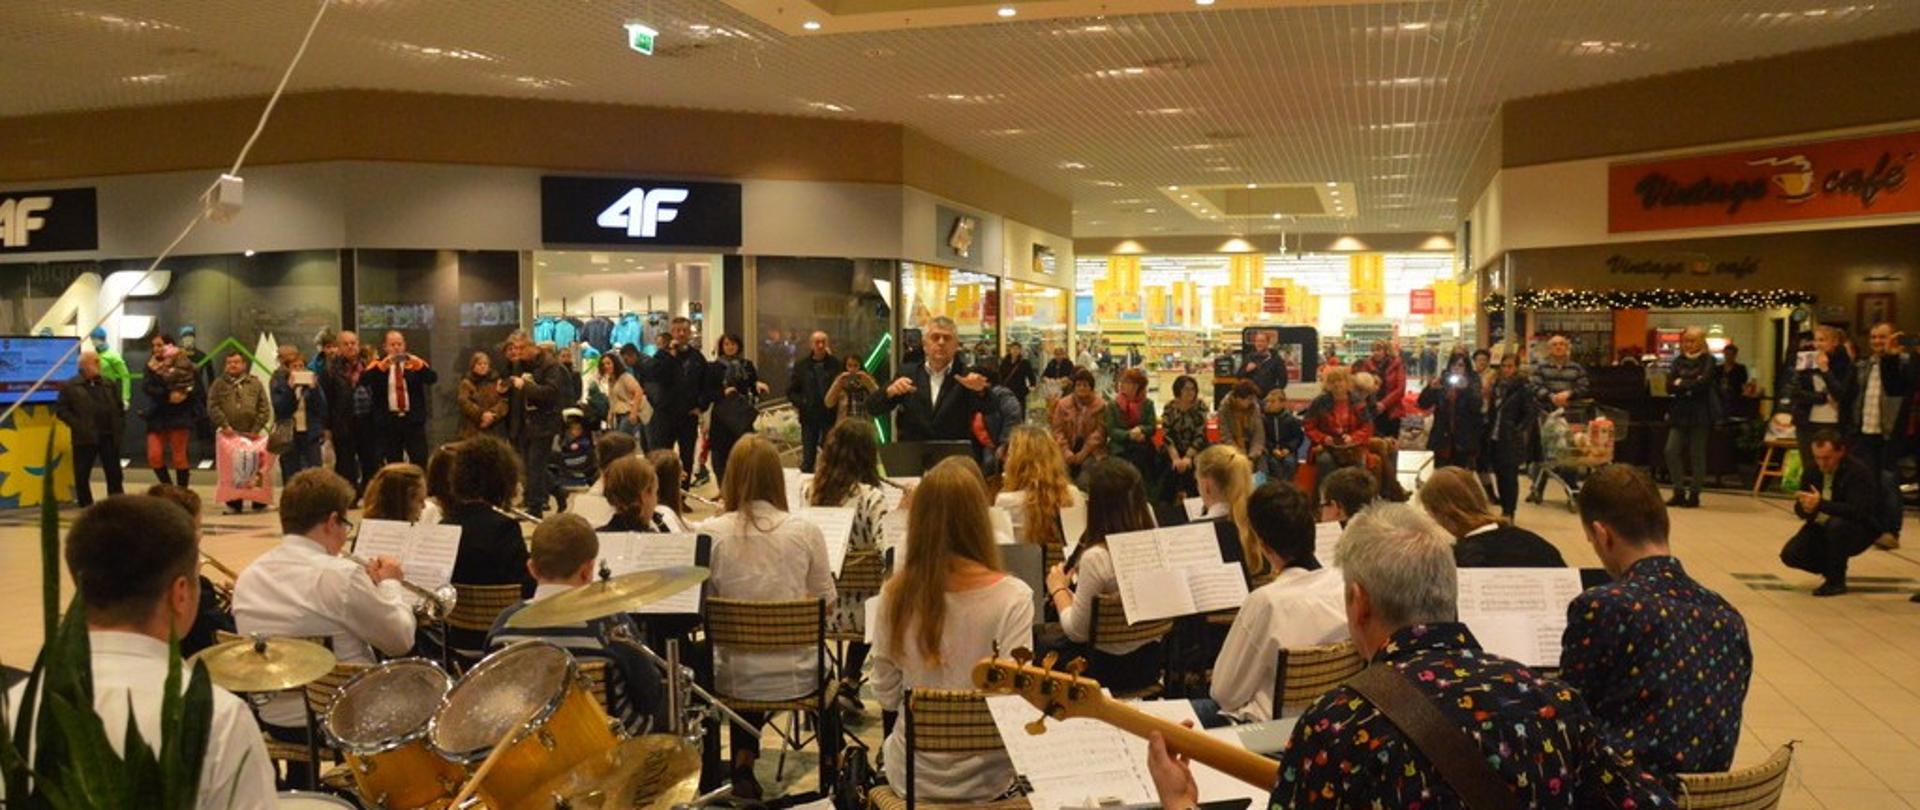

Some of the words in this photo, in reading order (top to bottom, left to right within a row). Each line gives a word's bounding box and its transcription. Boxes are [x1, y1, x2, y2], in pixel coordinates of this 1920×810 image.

[1634, 171, 1768, 215] Vintage
[1823, 151, 1913, 208] café
[596, 187, 689, 237] 4F
[1606, 254, 1684, 280] Vintage
[30, 269, 172, 357] 4F
